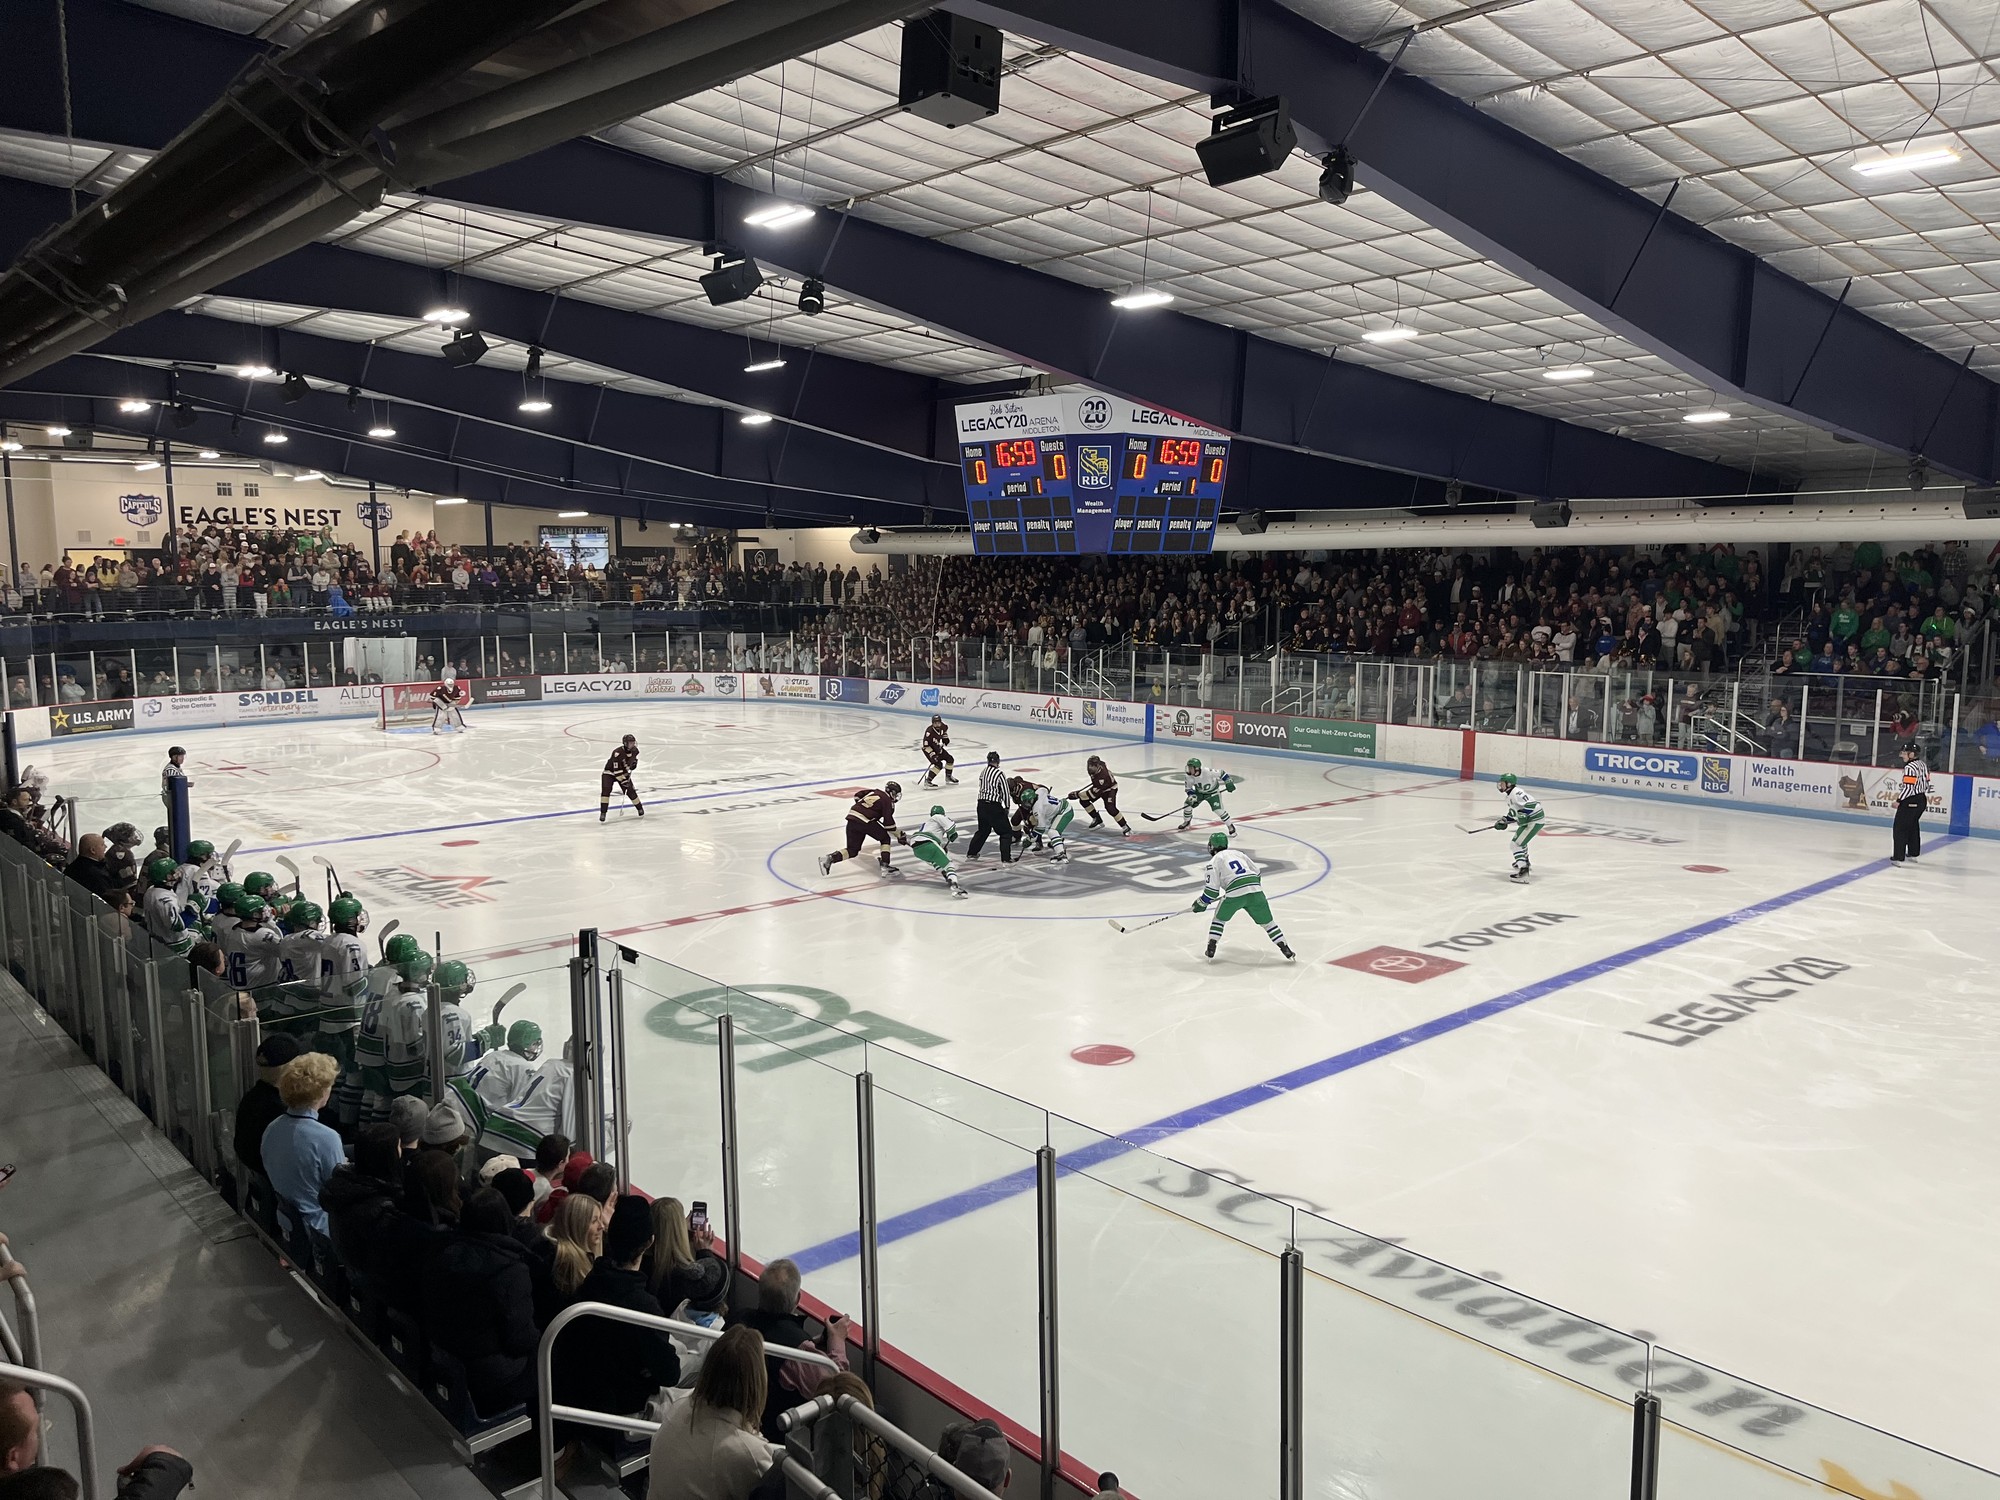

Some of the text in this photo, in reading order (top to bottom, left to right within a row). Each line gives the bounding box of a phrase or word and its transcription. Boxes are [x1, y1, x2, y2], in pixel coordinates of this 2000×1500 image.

[989, 404, 1003, 416] Bob
[961, 414, 1027, 432] LEGACY20
[1029, 416, 1059, 426] ARENA
[1022, 425, 1060, 435] MIDDLETON
[1040, 440, 1064, 452] Guests
[1128, 438, 1148, 451] Home
[1204, 443, 1226, 456] Guests
[965, 447, 983, 458] Home
[996, 440, 1036, 467] 16:59
[1159, 439, 1200, 466] 16:59
[975, 460, 988, 484] 0
[1053, 454, 1067, 479] 0
[1133, 453, 1147, 479] 0
[1210, 458, 1223, 483] 0
[1036, 477, 1042, 494] 1
[1082, 475, 1108, 486] RBC
[1161, 481, 1182, 493] period
[1190, 479, 1196, 494] 1
[1007, 482, 1027, 495] period
[120, 497, 161, 513] CAPITOLS
[358, 504, 391, 519] CAPOLS
[180, 506, 341, 526] EAGLE'S NEST
[974, 520, 1018, 532] player penalty
[1026, 519, 1073, 531] penalty player
[1114, 518, 1161, 530] player penalty
[1168, 519, 1213, 531] penalty player
[315, 618, 404, 630] EAGLE'S NEST
[486, 688, 526, 697] KRAEMER
[544, 679, 632, 694] LEGACY20
[238, 690, 319, 707] SONDEL
[885, 688, 900, 701] TDS
[982, 701, 1021, 712] WEST BEND
[1030, 706, 1074, 721] ACTUATE
[1106, 703, 1127, 713] Wealth
[73, 708, 133, 725] U.S. ARMY
[1106, 713, 1145, 725] Management
[1172, 723, 1194, 735] STATE
[1237, 722, 1287, 739] TOYOTA
[1321, 729, 1348, 737] Net-Zero
[1348, 731, 1371, 739] Carbon
[1594, 752, 1681, 775] TRICOR
[1752, 763, 1795, 777] Wealth
[1590, 774, 1690, 791] INSURANCE
[1704, 781, 1728, 792] RBC
[1751, 777, 1833, 795] Management
[1977, 786, 2000, 799] Fir
[1870, 800, 1889, 808] ARE
[1423, 910, 1580, 954] TOYOTA
[1623, 955, 1852, 1048] LEGACY20
[447, 1029, 462, 1043] 34
[1144, 1166, 1330, 1228] SC
[1300, 1236, 1807, 1438] Aviation
